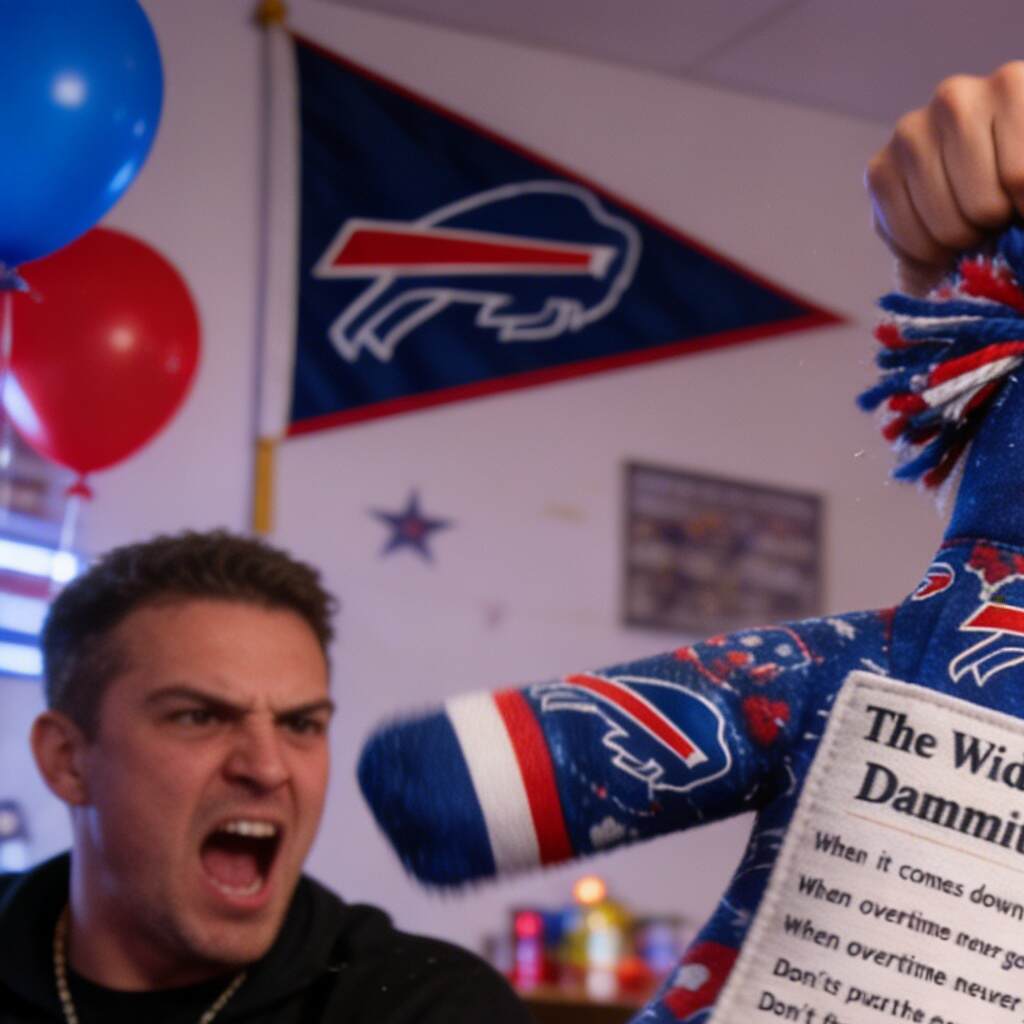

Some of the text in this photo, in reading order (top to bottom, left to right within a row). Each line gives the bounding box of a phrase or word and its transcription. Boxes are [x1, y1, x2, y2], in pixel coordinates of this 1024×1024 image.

[861, 703, 939, 760] The
[813, 830, 869, 865] When
[875, 850, 893, 873] it
[898, 864, 965, 898] comes
[968, 883, 1024, 922] down
[782, 913, 841, 951] When
[845, 940, 948, 987] overtime
